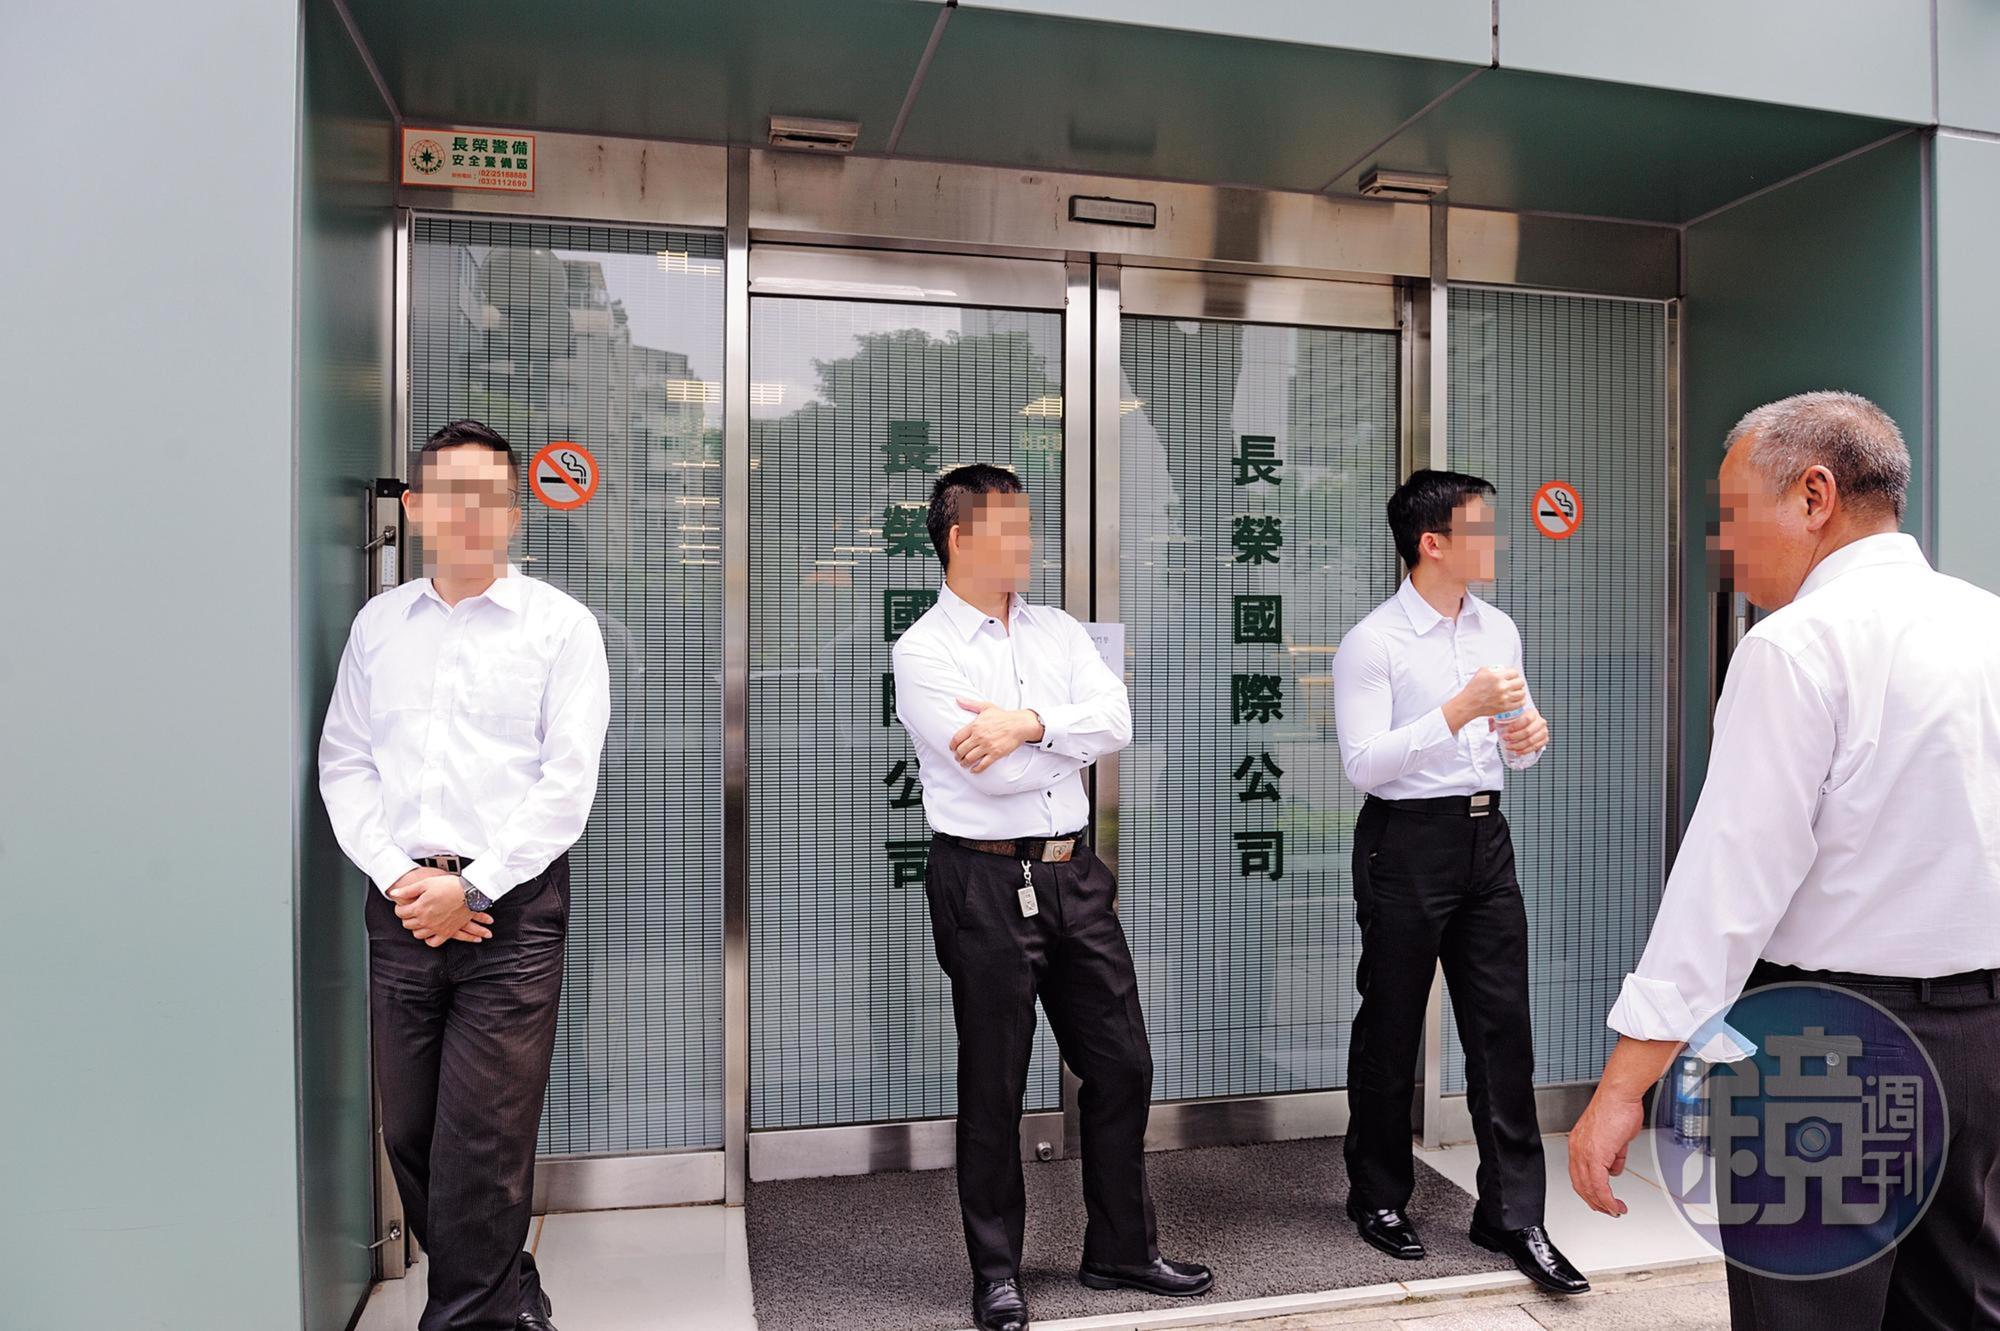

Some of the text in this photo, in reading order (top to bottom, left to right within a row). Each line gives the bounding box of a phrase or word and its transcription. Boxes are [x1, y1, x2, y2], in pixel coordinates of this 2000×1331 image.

[452, 137, 528, 155] 長榮警備
[881, 421, 939, 889] 長榮國公司
[1231, 435, 1284, 882] 長榮國際公司
